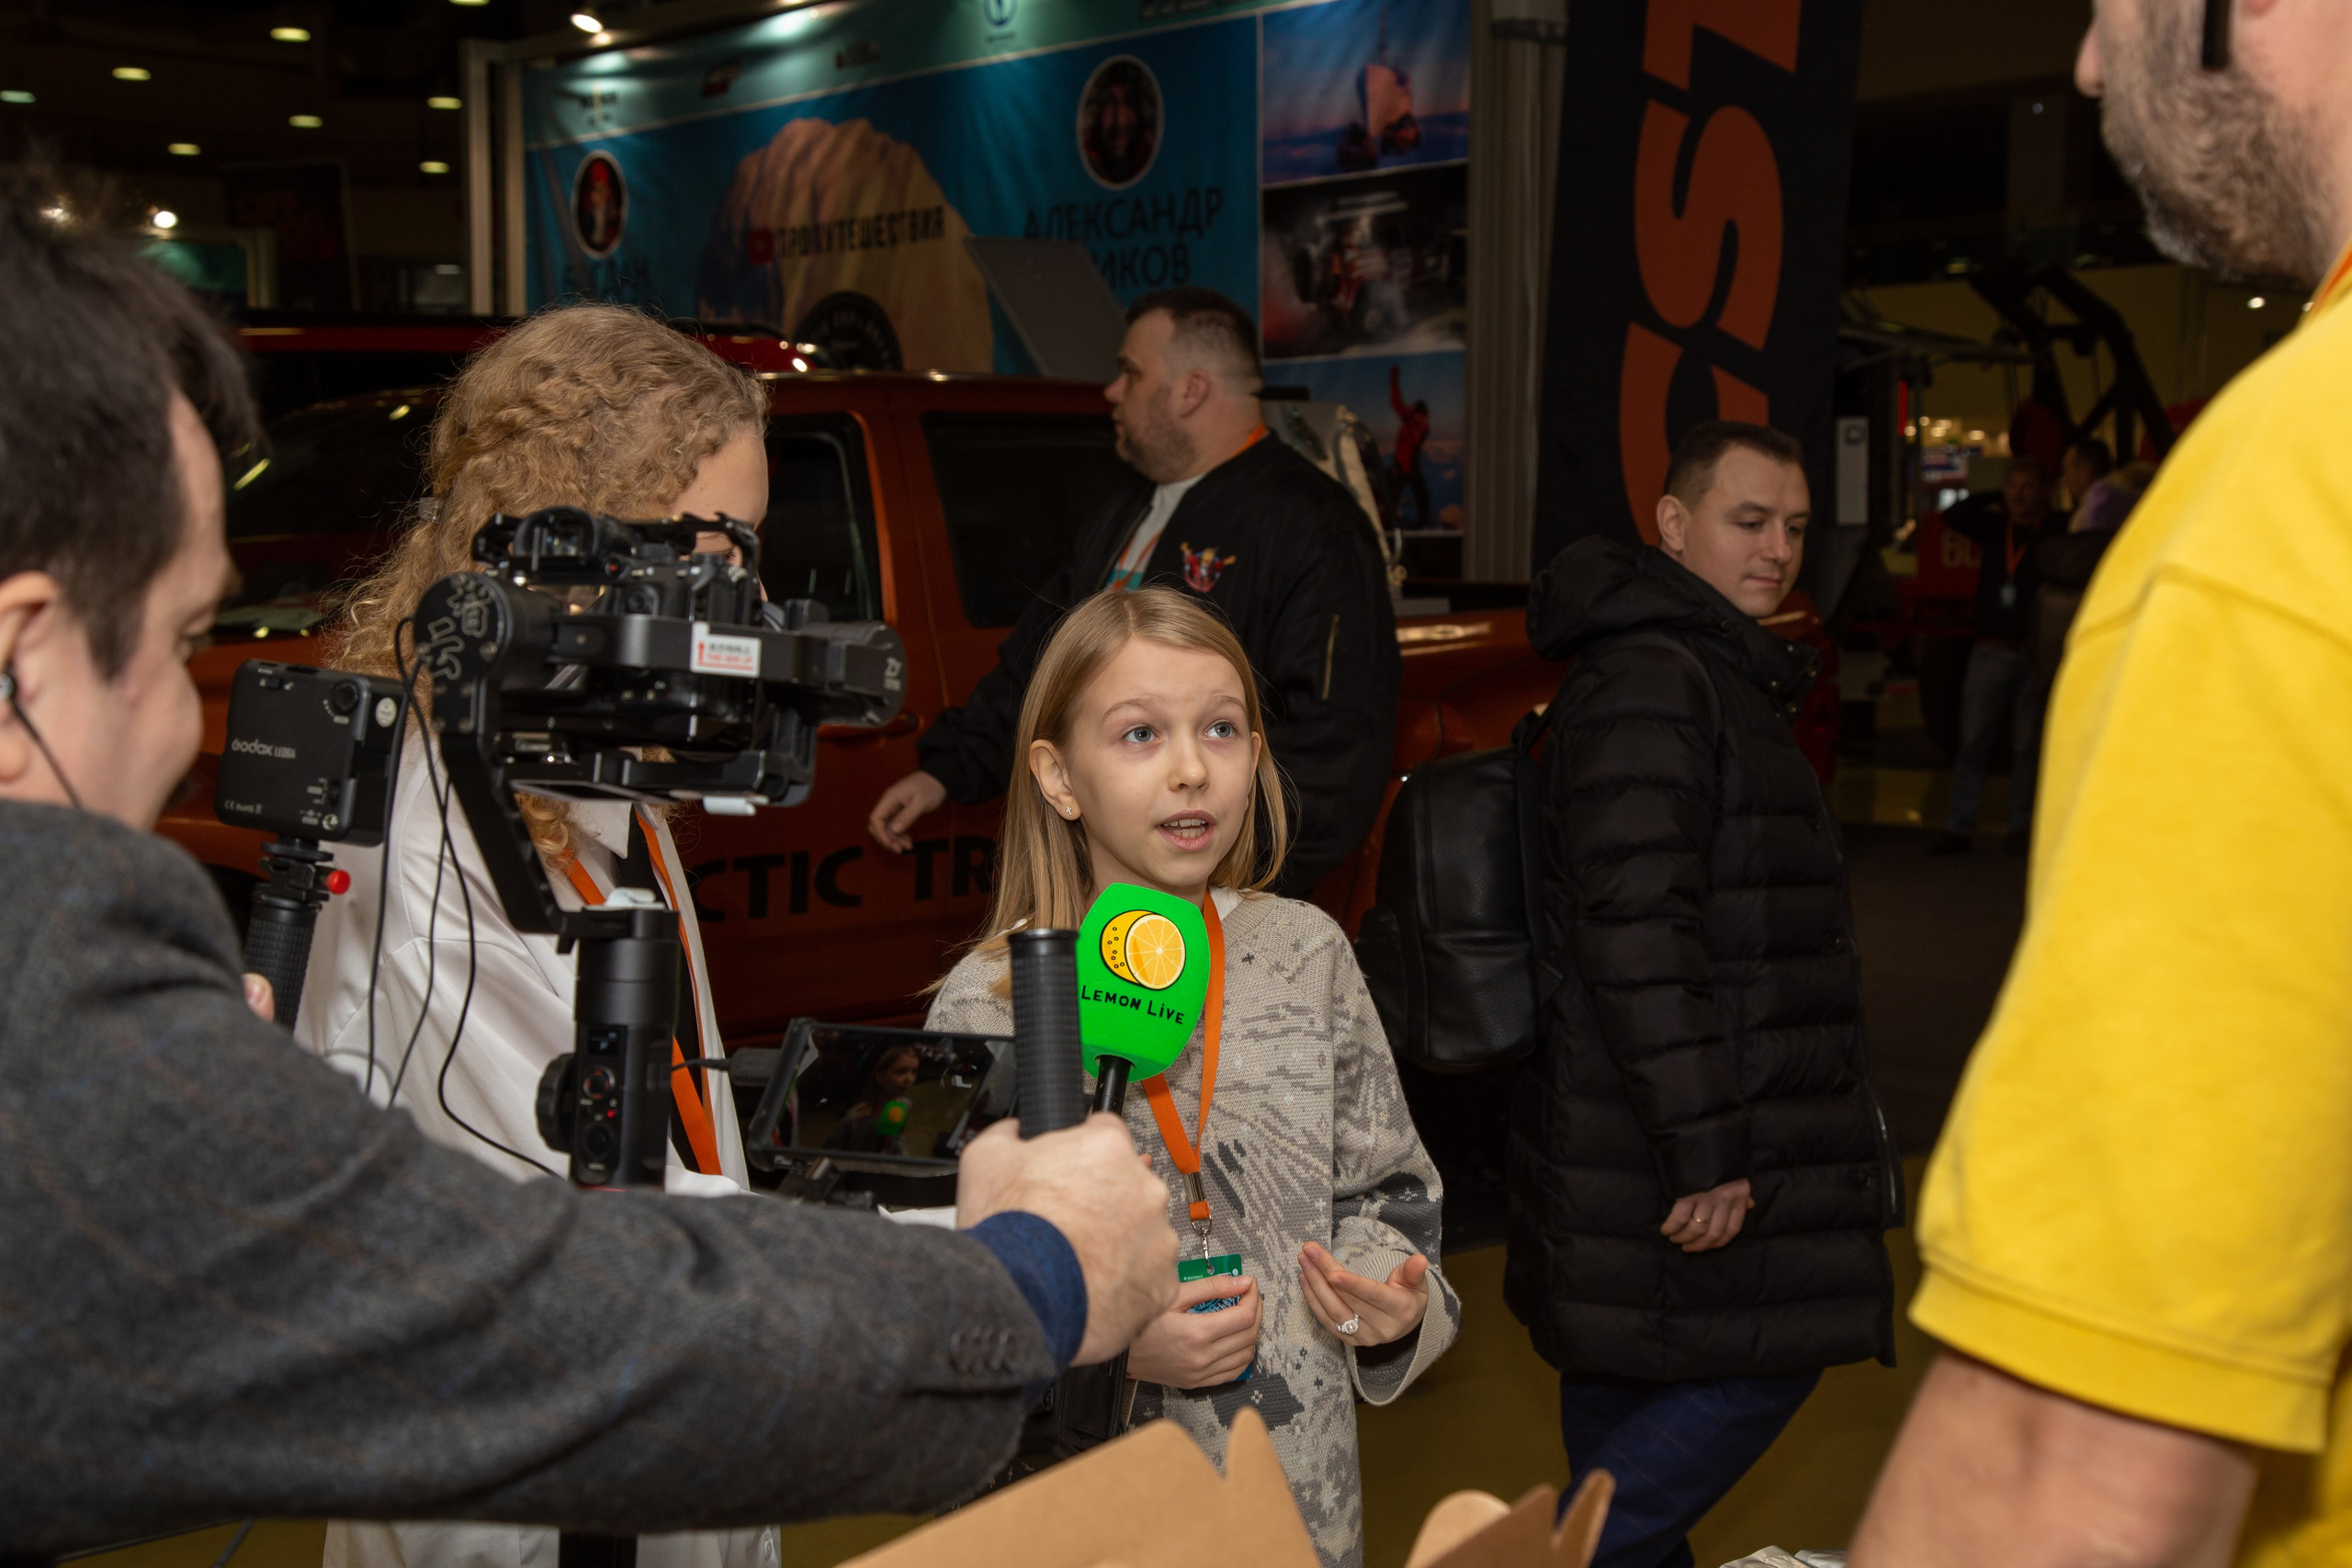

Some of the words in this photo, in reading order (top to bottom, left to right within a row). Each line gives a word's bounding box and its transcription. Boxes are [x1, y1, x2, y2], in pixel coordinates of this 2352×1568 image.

[1023, 186, 1224, 243] АЛЕКСАНДР
[1091, 243, 1192, 290] ИКОВ
[231, 738, 274, 757] Godox
